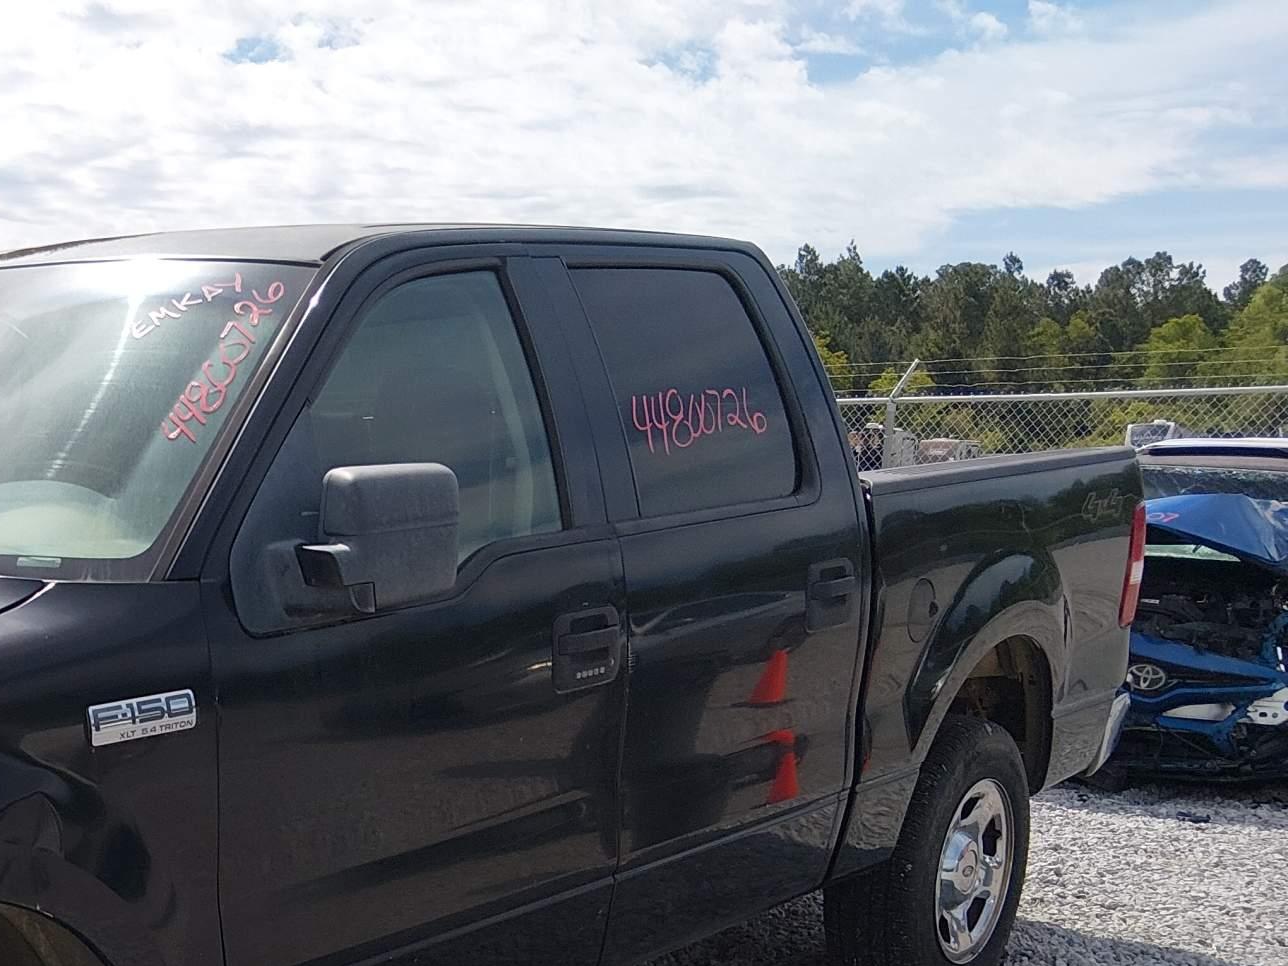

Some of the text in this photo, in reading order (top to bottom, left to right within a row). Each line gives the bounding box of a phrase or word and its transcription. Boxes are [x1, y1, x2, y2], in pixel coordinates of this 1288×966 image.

[161, 281, 285, 443] 44800726
[632, 386, 768, 456] 44800726
[92, 692, 194, 732] F-150
[119, 728, 136, 740] XLT
[159, 719, 194, 732] TRITON
